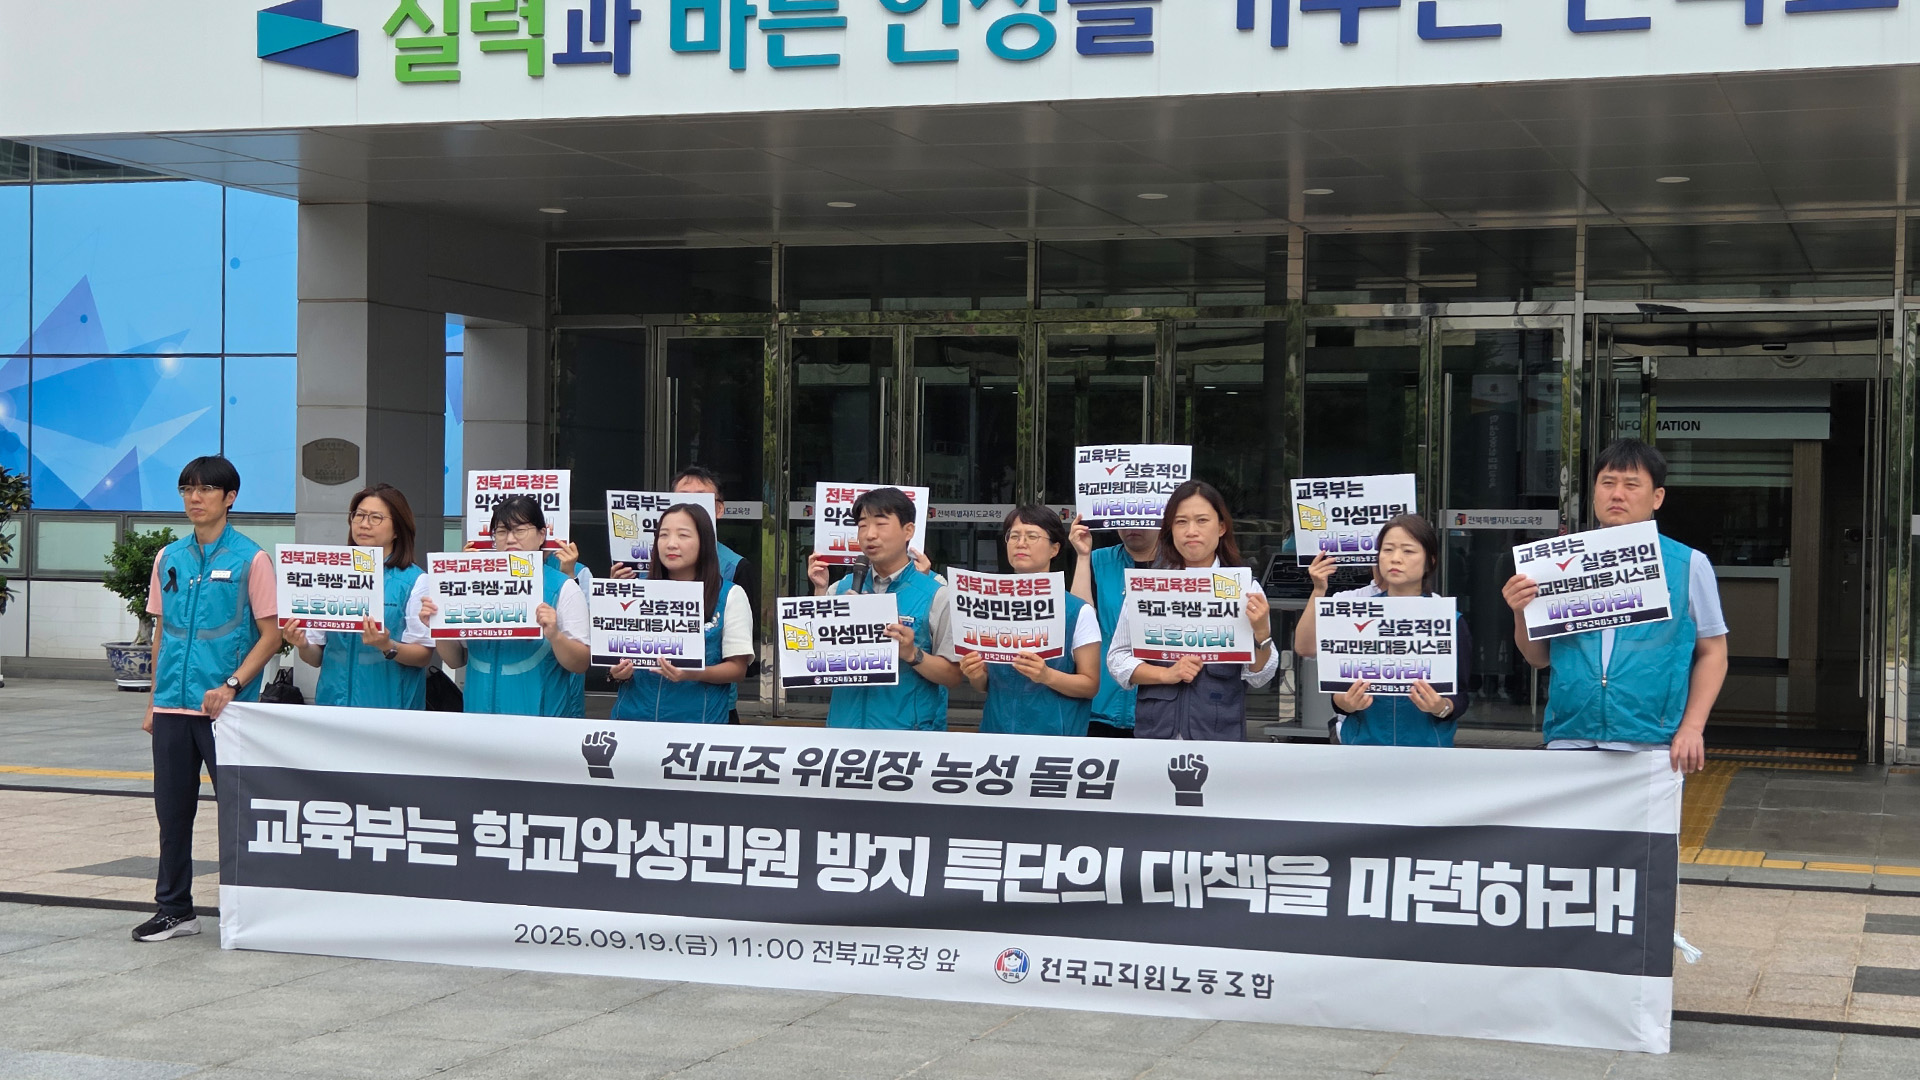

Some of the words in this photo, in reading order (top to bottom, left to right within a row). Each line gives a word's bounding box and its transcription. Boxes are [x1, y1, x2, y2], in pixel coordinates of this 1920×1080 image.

[1618, 419, 1701, 432] NFOMATION
[1079, 448, 1130, 464] 교육부는
[1124, 463, 1187, 479] 실효적인
[476, 474, 559, 491] 전북교육청은
[1296, 480, 1364, 500] 교육부는
[611, 494, 671, 512] 교육부는
[1468, 516, 1543, 525] 전북특별자치도교육청
[281, 550, 351, 566] 전북교육청은
[1518, 538, 1586, 564] 교육부는
[1581, 543, 1658, 572] 실효적인
[432, 558, 508, 573] 전북교육청은
[287, 572, 374, 590] 학교·학생·교사
[439, 580, 533, 596] 학교·학생·교사
[592, 581, 645, 598] 교육부는
[956, 574, 1052, 597] 전북교육청은
[1129, 576, 1211, 593] 전북교육청은
[1535, 564, 1661, 597] 교민원대응시스템
[291, 594, 370, 617] 보호하라!
[639, 599, 700, 617] 실효적인
[782, 599, 850, 619] 교육부는
[956, 595, 1055, 621] 악성민원인
[1137, 600, 1240, 618] 학교·학생·교사
[1319, 601, 1384, 618] 교육부는
[1546, 585, 1644, 620] 마련하라!
[444, 602, 527, 624] 보호하라!
[592, 616, 700, 634] 학교민원대응시스템
[818, 623, 892, 645] 악성민원
[962, 622, 1049, 648] 고발하라!
[1377, 619, 1452, 637] 실효적인
[608, 634, 684, 655] 마련하라!
[1144, 623, 1235, 648] 보호하라!
[1320, 639, 1452, 655] 학교민원대응시스템
[806, 648, 892, 673] 해결하라!
[1339, 658, 1432, 680] 마련하라!
[661, 742, 787, 785] 전교조
[792, 747, 923, 792] 위원장
[931, 752, 1020, 796] 농성
[1029, 756, 1120, 800] 돌입
[248, 798, 459, 867] 교육부는
[472, 809, 801, 889] 학교악성민원
[816, 830, 931, 897] 방지
[943, 837, 1124, 904] 특단의
[1140, 850, 1332, 917] 대책을
[1347, 856, 1637, 935] 마련하라!
[513, 923, 718, 957] 2025.09.19.(금)
[727, 937, 804, 961] 11:00
[812, 939, 929, 971] 전북교육청
[935, 948, 961, 973] 앞
[1039, 956, 1275, 1000] 전국교직원노동조합
